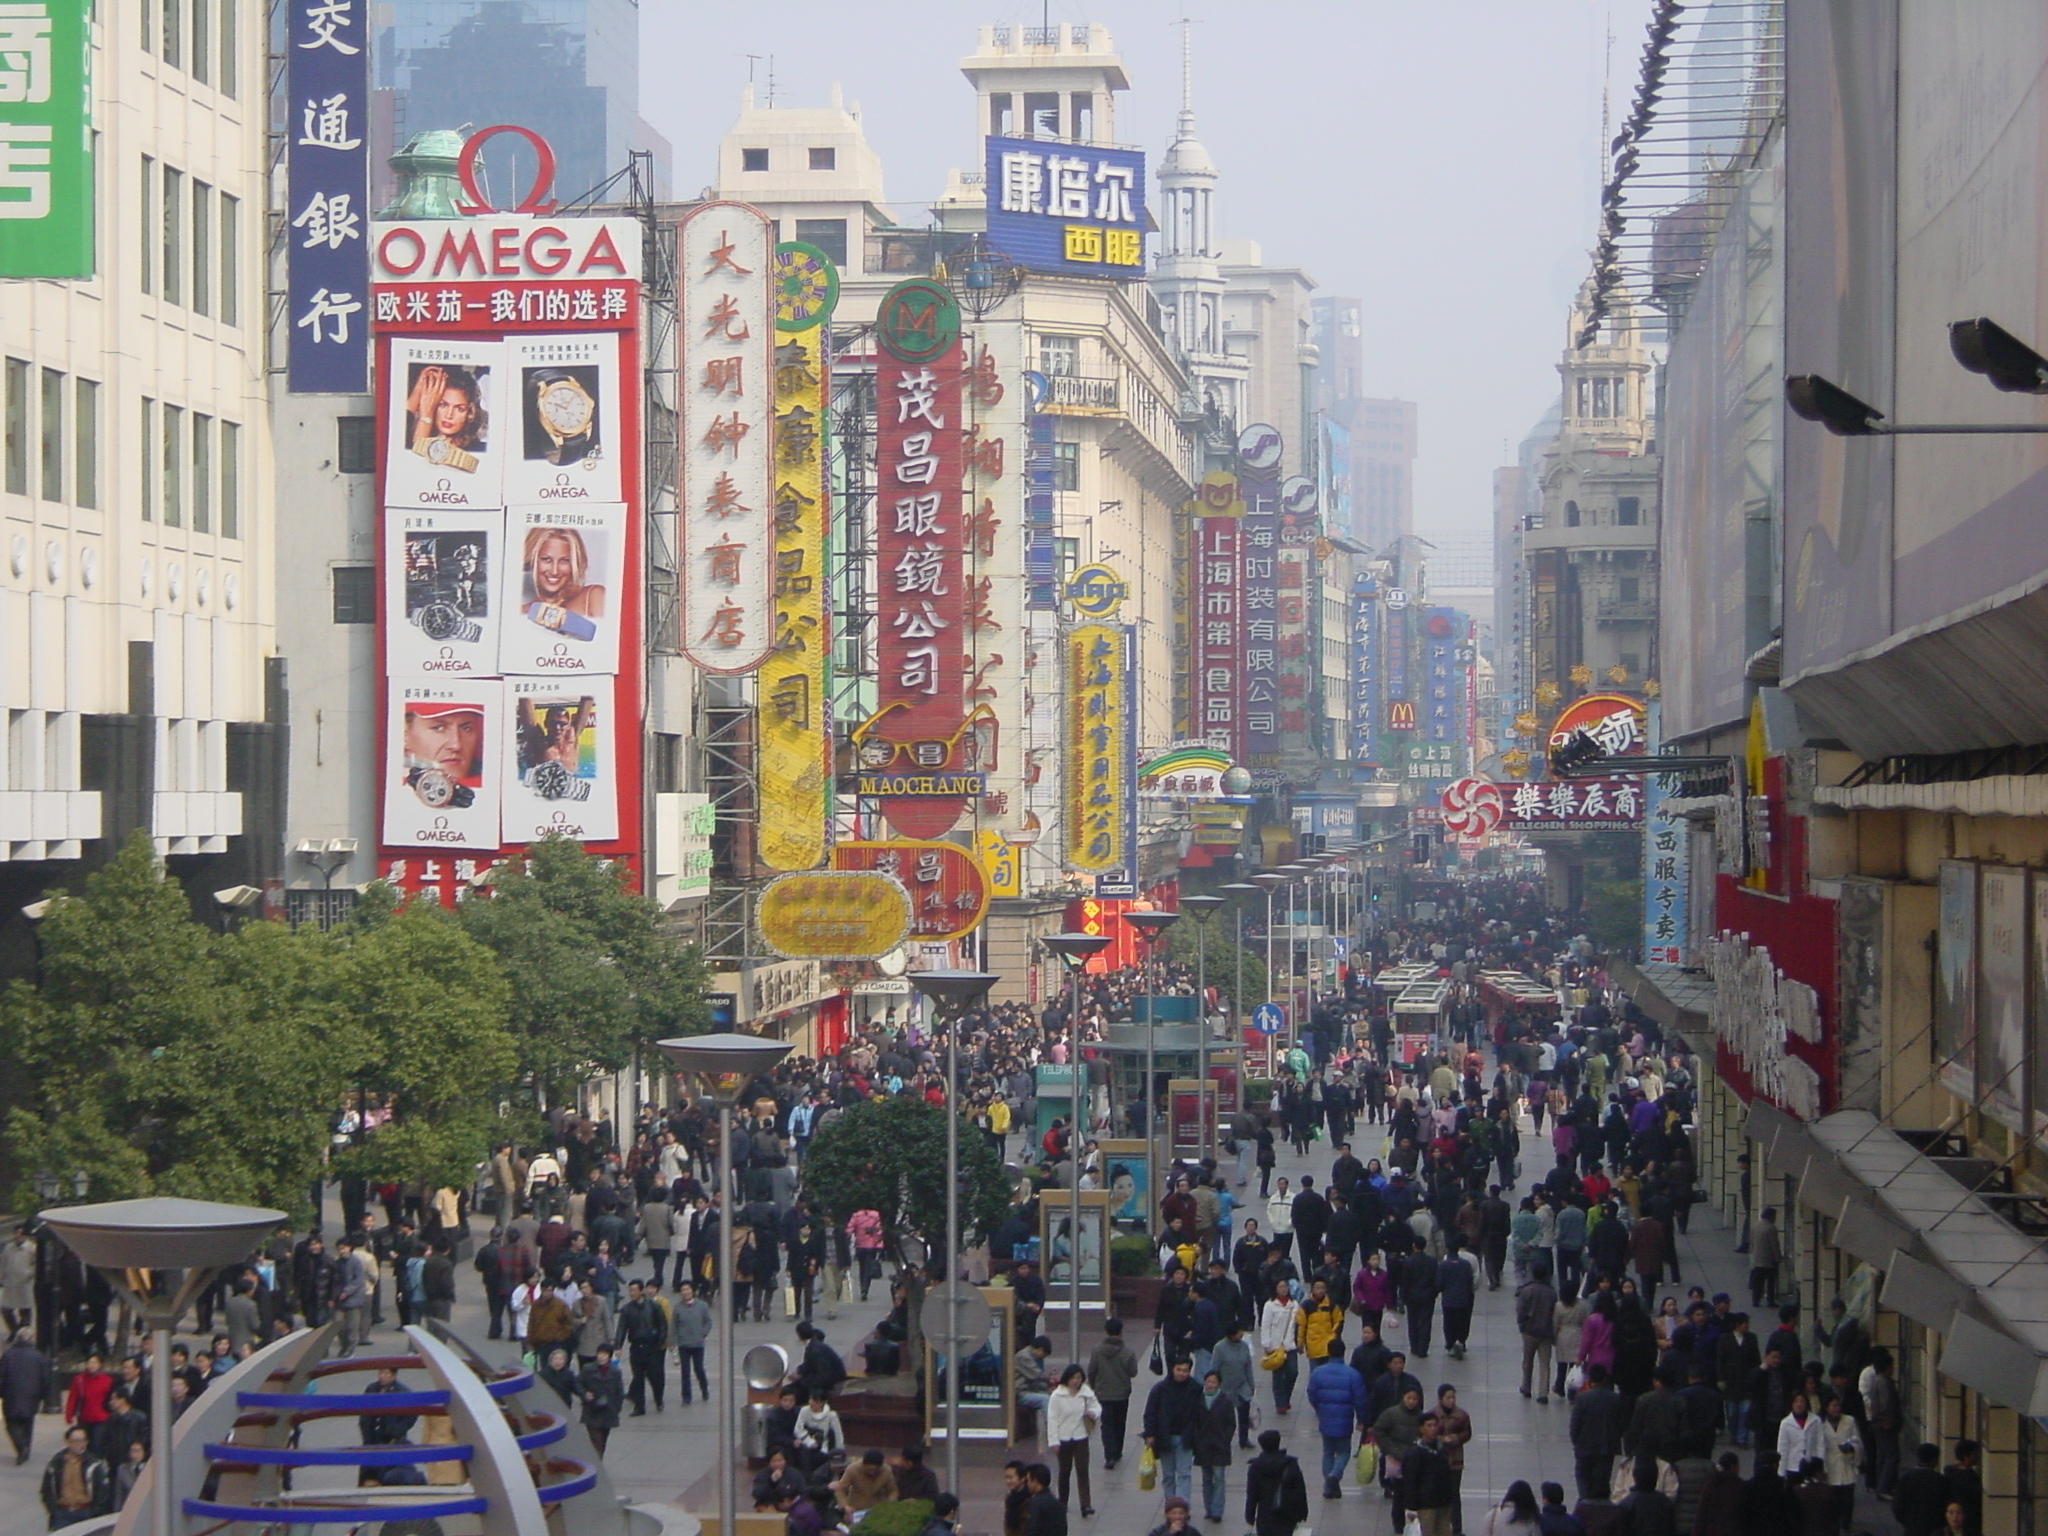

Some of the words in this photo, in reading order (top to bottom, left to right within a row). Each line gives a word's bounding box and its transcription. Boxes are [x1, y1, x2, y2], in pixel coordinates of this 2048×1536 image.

[293, 0, 361, 344] 交通銀行
[1001, 151, 1136, 222] 康培尔
[378, 225, 627, 275] OMEGA
[1064, 225, 1142, 266] 西服
[419, 491, 469, 504] OMEGA
[539, 487, 589, 499] OMEGA
[1245, 493, 1276, 736] 上海时装有限公司
[423, 661, 471, 671] OMEGA
[536, 657, 585, 669] OMEGA
[859, 776, 982, 795] MAOCHANG
[535, 825, 584, 837] OMEGA
[1569, 821, 1629, 830] SHOPPING
[416, 830, 466, 842] OMEGA
